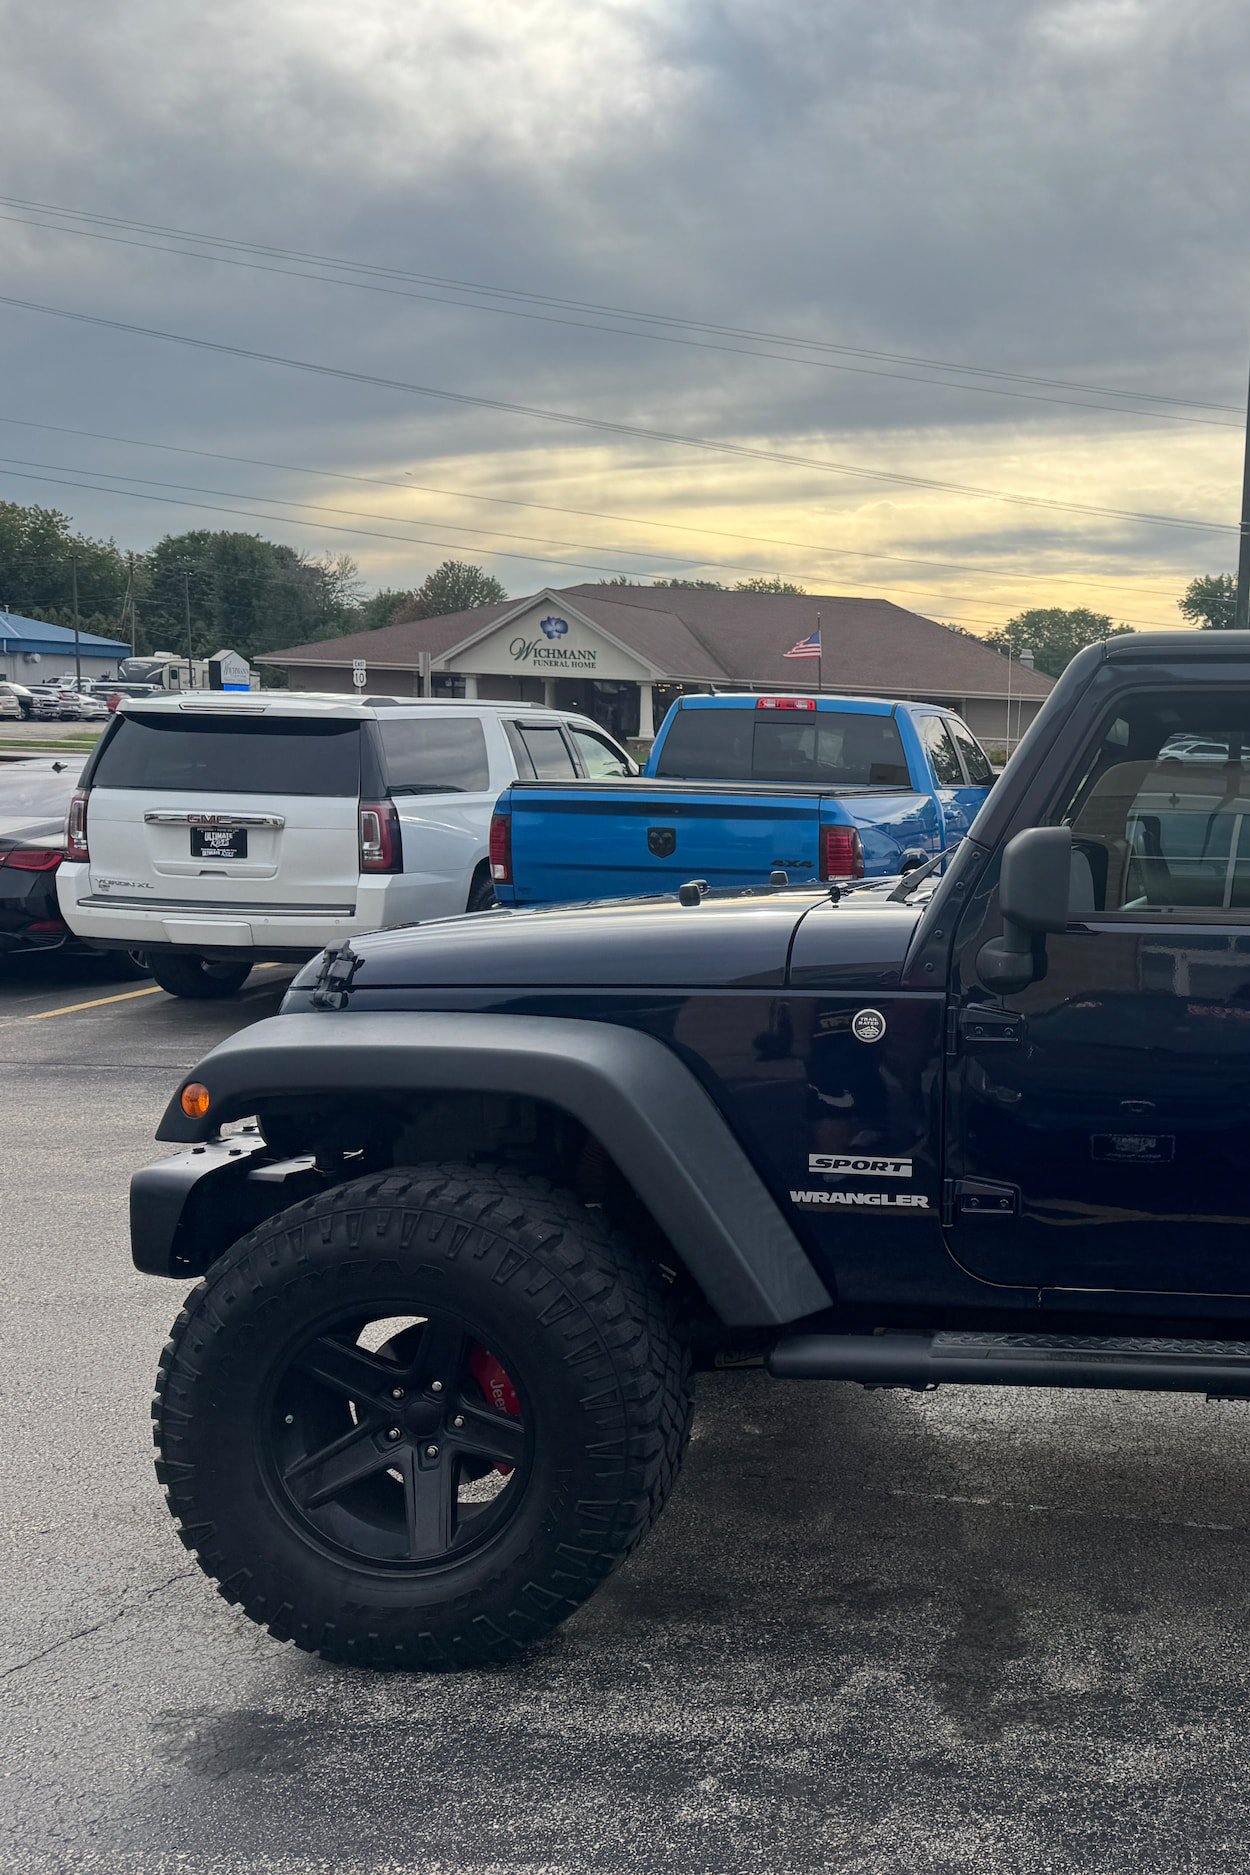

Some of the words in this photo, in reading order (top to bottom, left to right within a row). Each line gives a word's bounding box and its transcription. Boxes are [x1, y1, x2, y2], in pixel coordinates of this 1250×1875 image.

[533, 659, 570, 668] FUNERAL
[571, 661, 597, 669] HOME
[355, 672, 365, 684] 10
[188, 814, 232, 824] GMC
[810, 1158, 913, 1173] SPORT
[789, 1190, 931, 1209] WRANGLER
